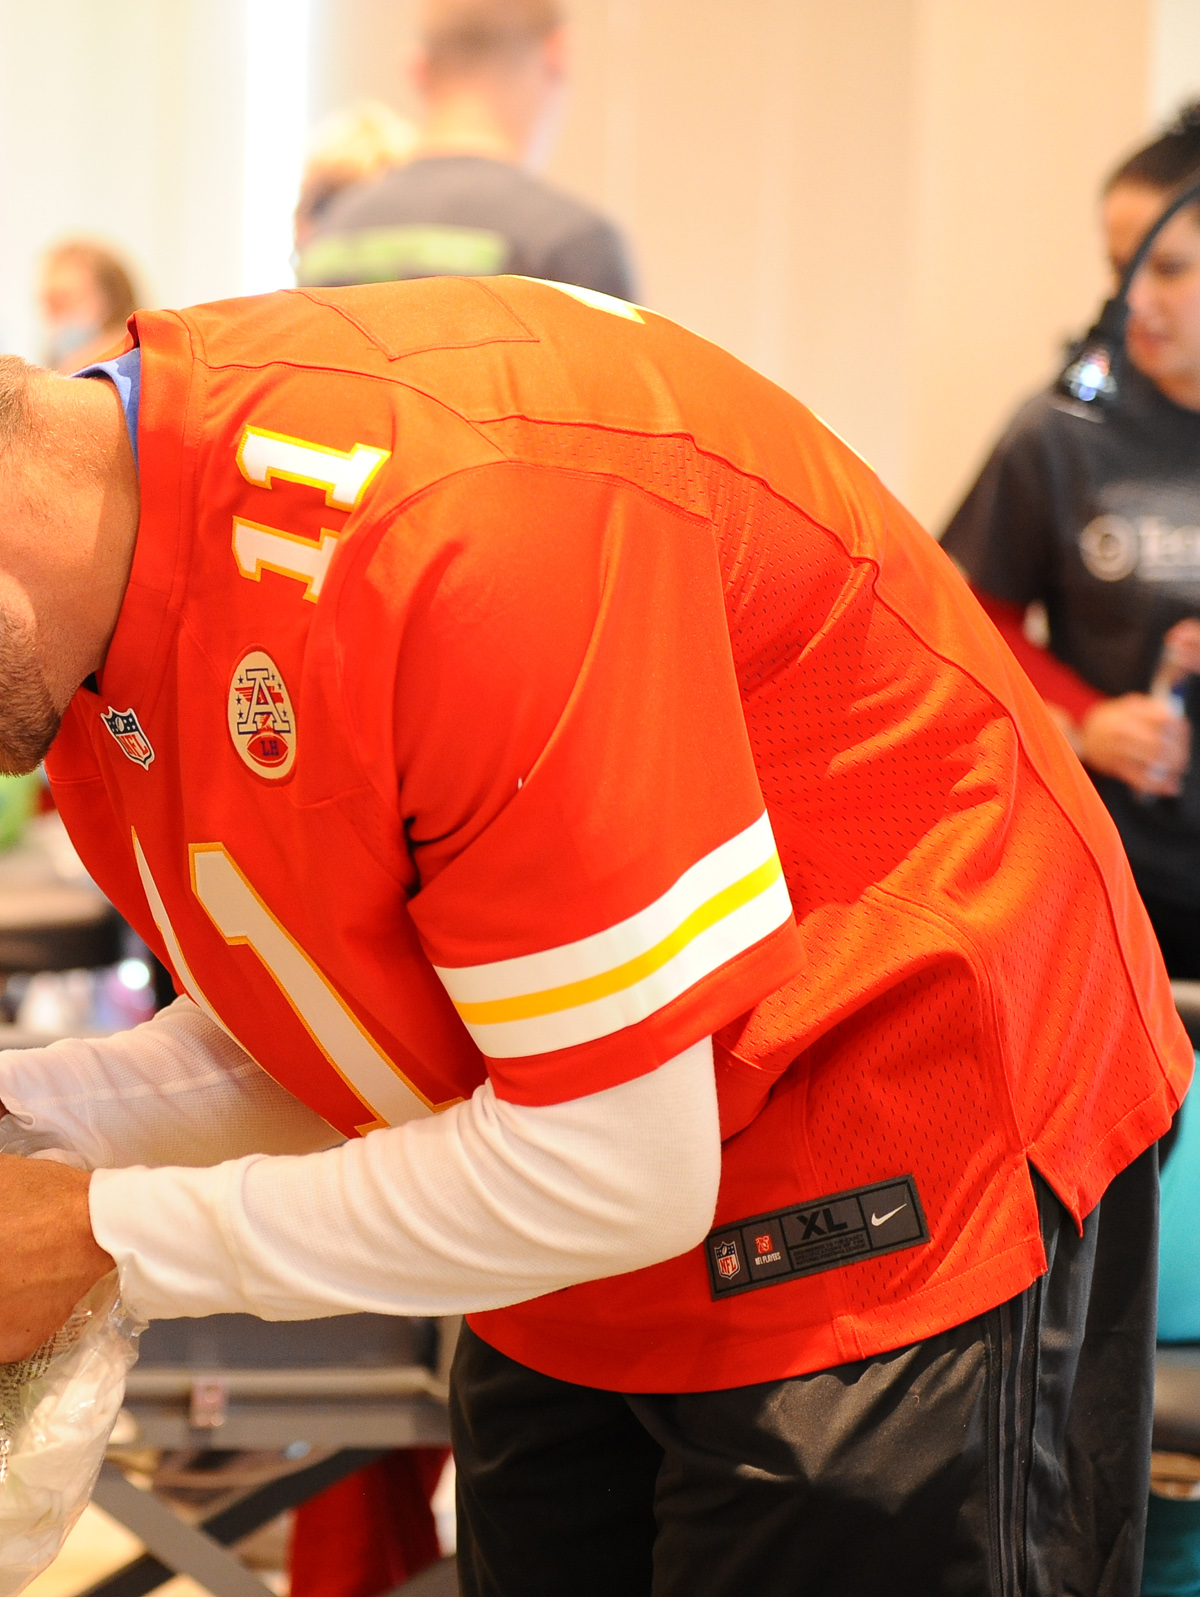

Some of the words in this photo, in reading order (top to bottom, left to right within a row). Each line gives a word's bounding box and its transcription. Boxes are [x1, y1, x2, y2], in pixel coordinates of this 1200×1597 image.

[232, 424, 392, 604] 11
[237, 668, 291, 735] A
[117, 733, 148, 757] NFL
[260, 740, 279, 756] LH
[796, 1208, 848, 1240] XL
[720, 1256, 737, 1274] NFL
